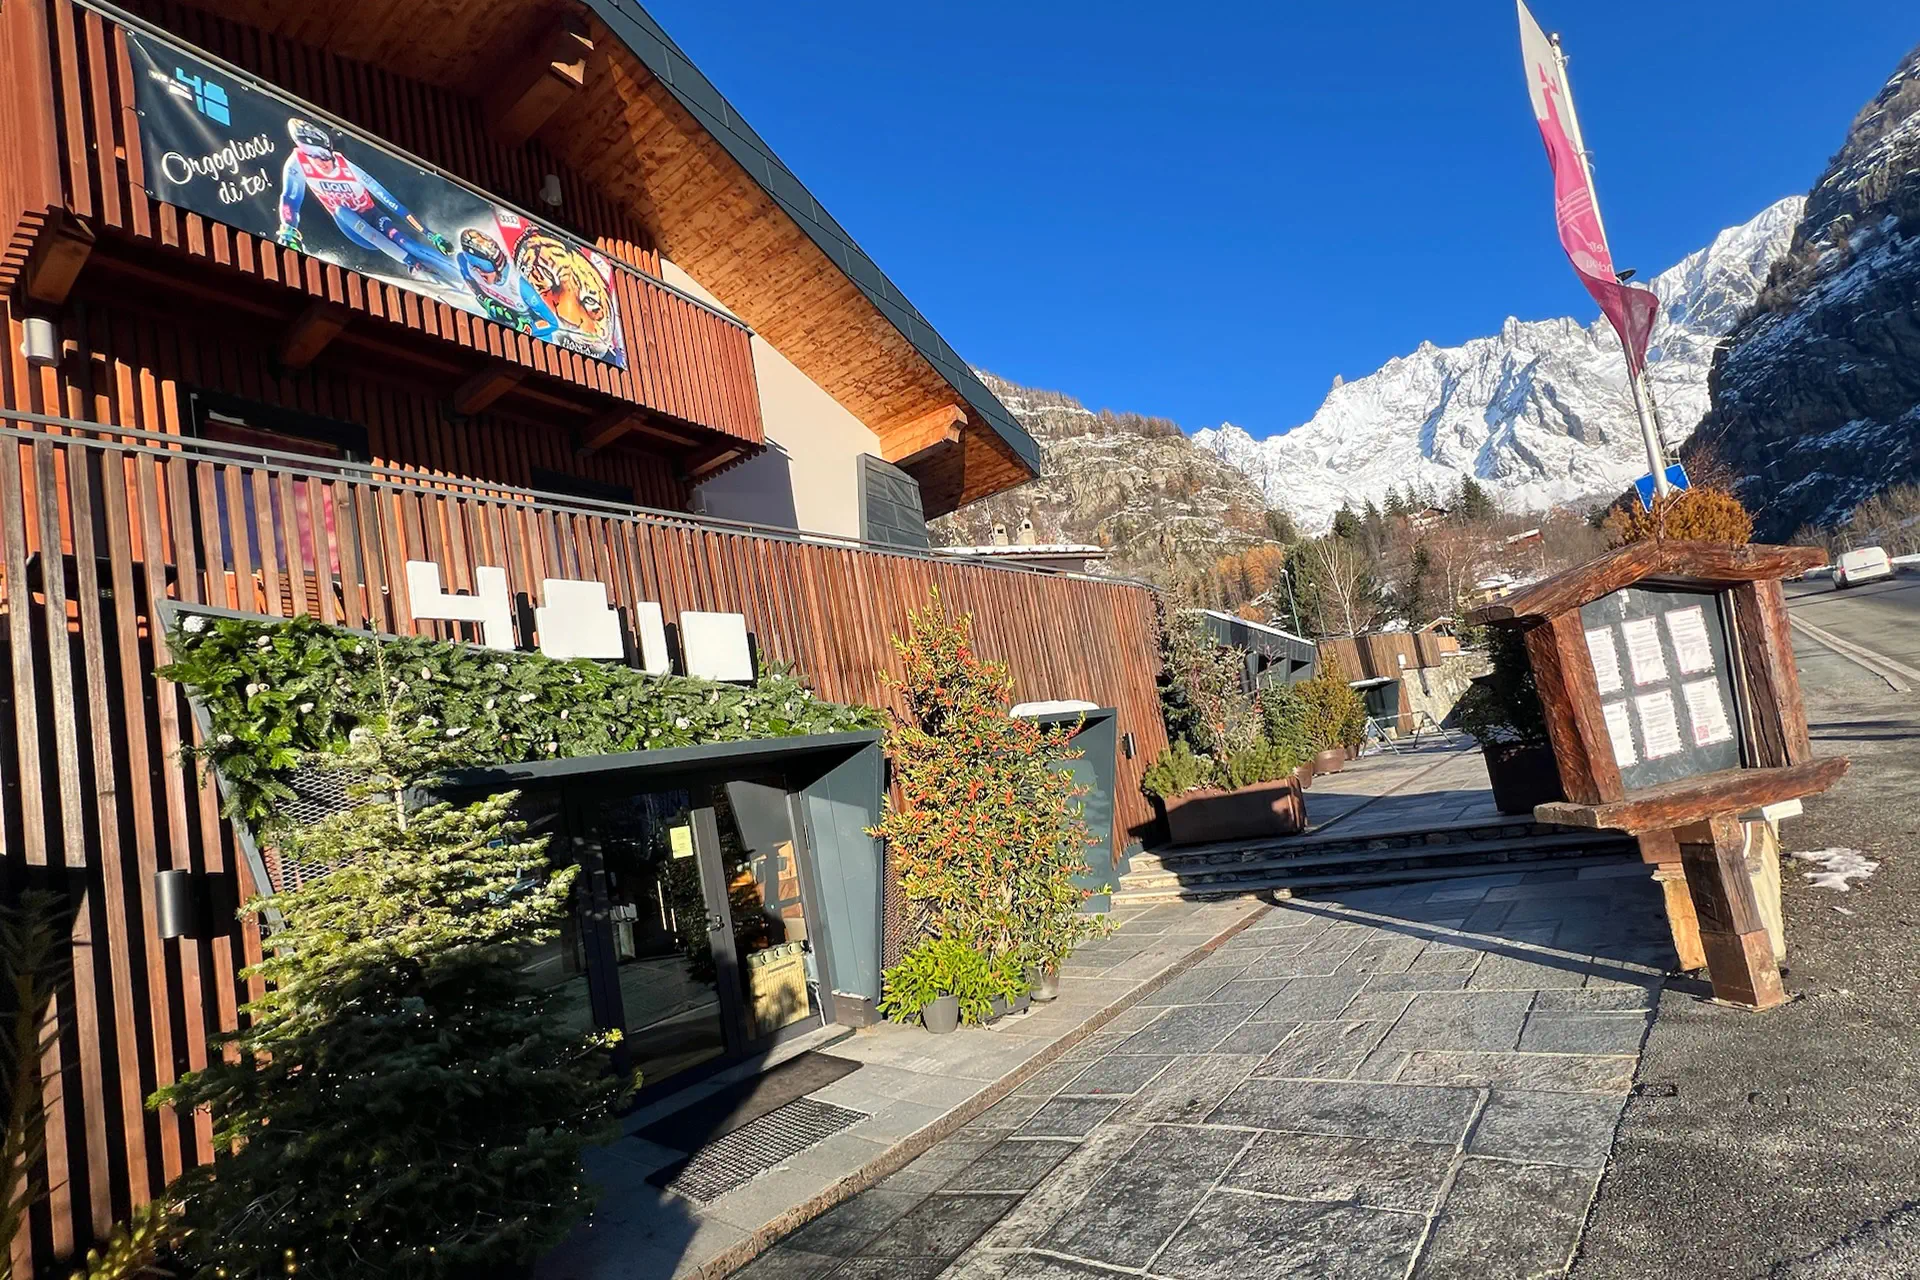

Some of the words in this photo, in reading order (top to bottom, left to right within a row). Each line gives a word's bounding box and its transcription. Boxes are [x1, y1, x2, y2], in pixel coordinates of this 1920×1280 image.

[161, 133, 274, 185] Orgogliosi
[218, 178, 244, 205] di
[244, 168, 271, 196] te!
[321, 182, 353, 193] LIQUI
[376, 190, 399, 211] Audi
